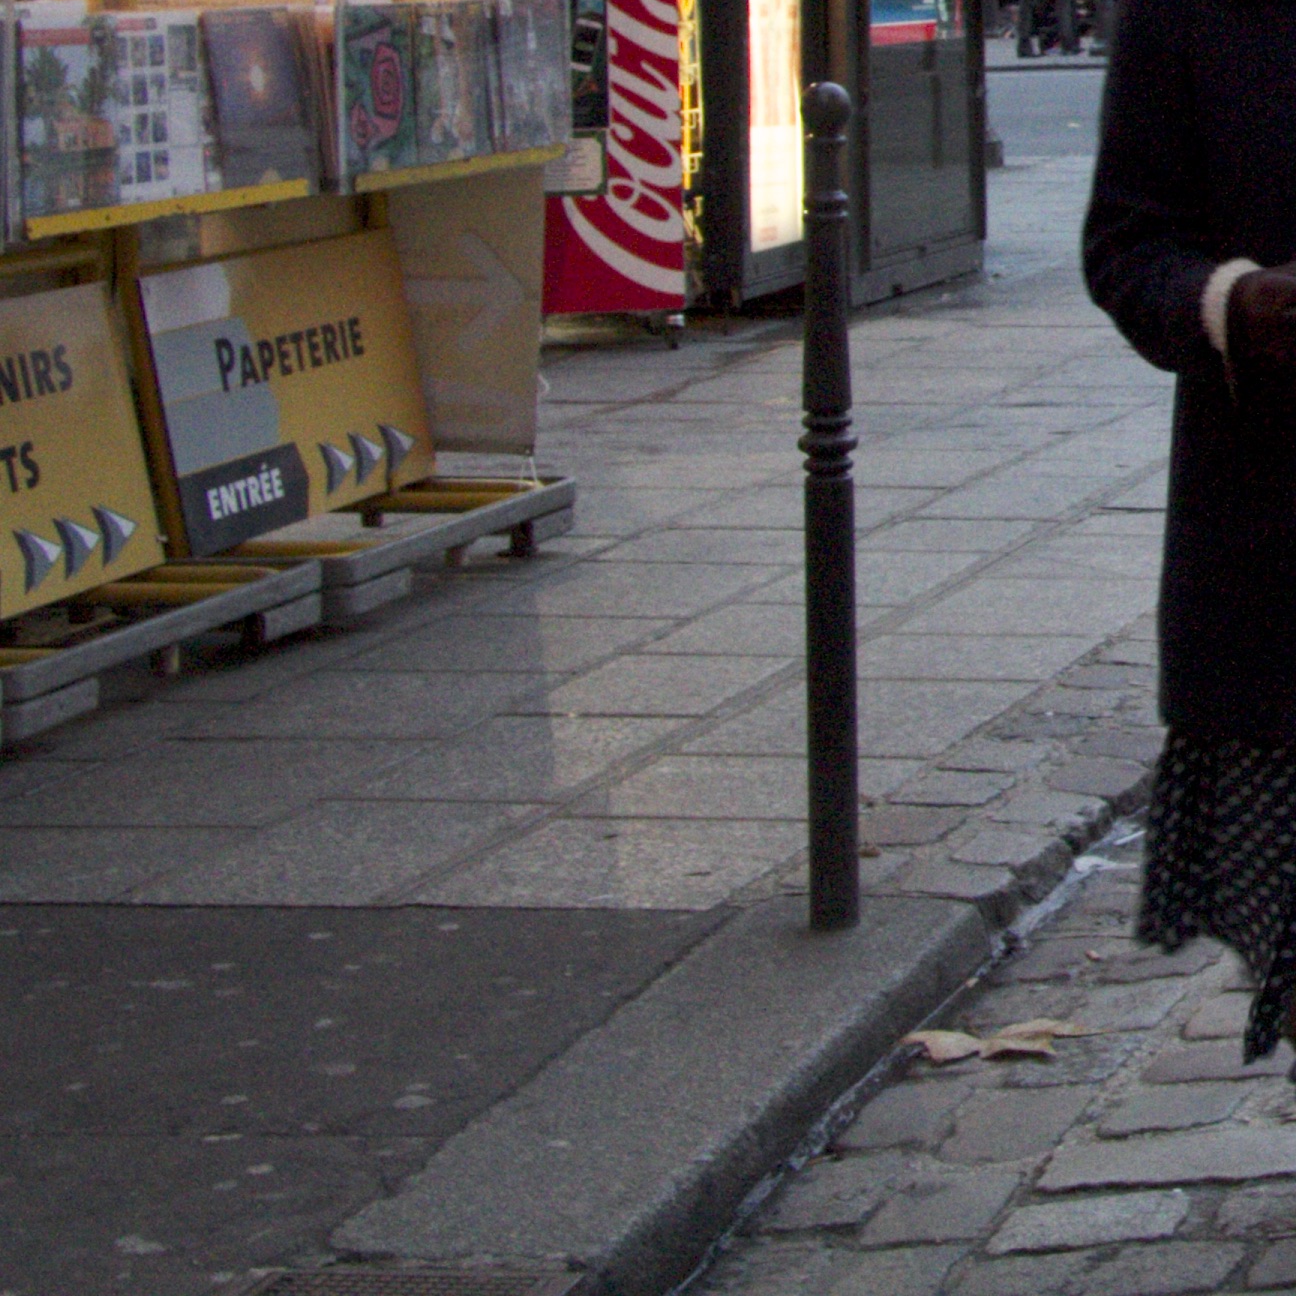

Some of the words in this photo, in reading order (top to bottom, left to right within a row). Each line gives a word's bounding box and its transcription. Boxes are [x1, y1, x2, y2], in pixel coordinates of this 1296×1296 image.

[0, 344, 74, 405] NIRS
[213, 316, 366, 393] PAPETERIE
[206, 463, 286, 521] ENTRÉE
